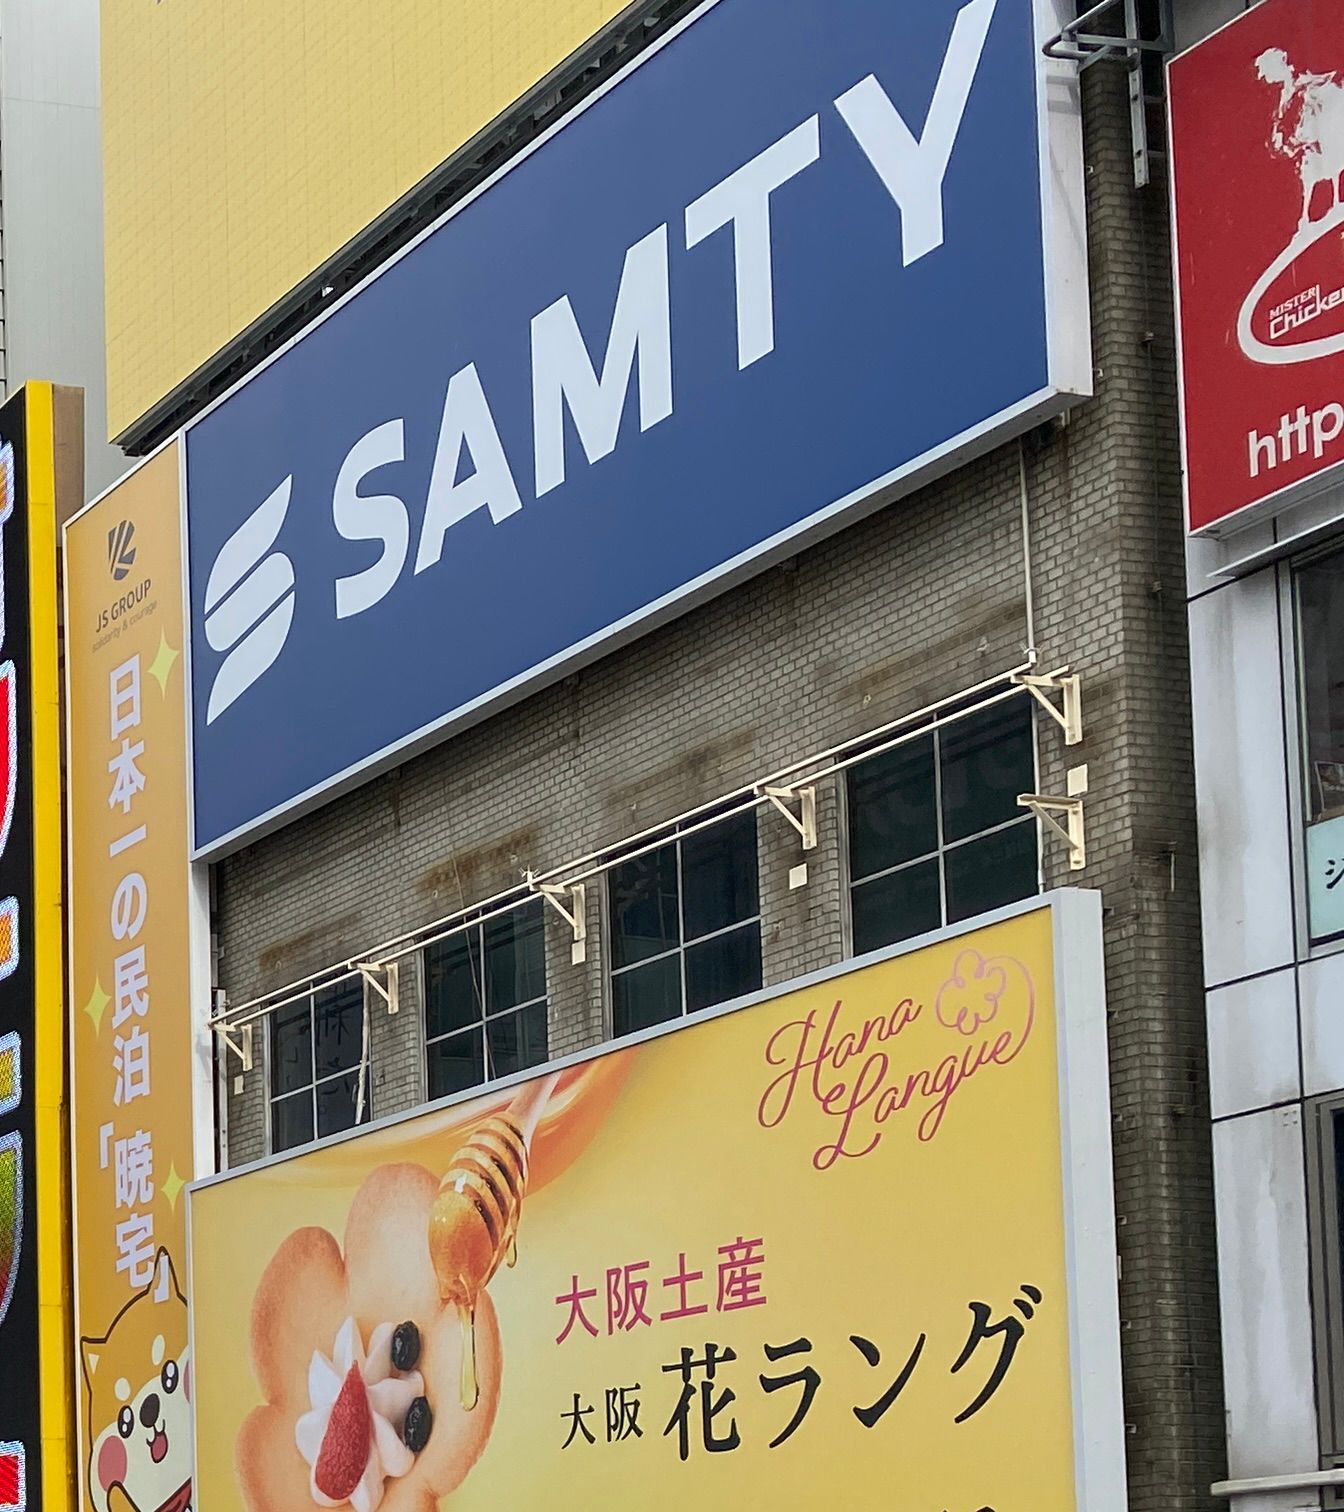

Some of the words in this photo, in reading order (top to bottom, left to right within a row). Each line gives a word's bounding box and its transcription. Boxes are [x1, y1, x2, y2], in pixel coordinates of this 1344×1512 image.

[332, 0, 997, 620] SAMTY
[1269, 284, 1344, 340] Chicke
[1270, 286, 1316, 319] MISTER
[95, 609, 109, 633] JS
[111, 578, 151, 621] GROUP
[758, 992, 923, 1130] Hana
[811, 1027, 1024, 1172] Langue
[555, 1236, 768, 1347] 大阪土産
[560, 1381, 643, 1451] 大阪
[660, 1285, 1044, 1463] 花ラング
